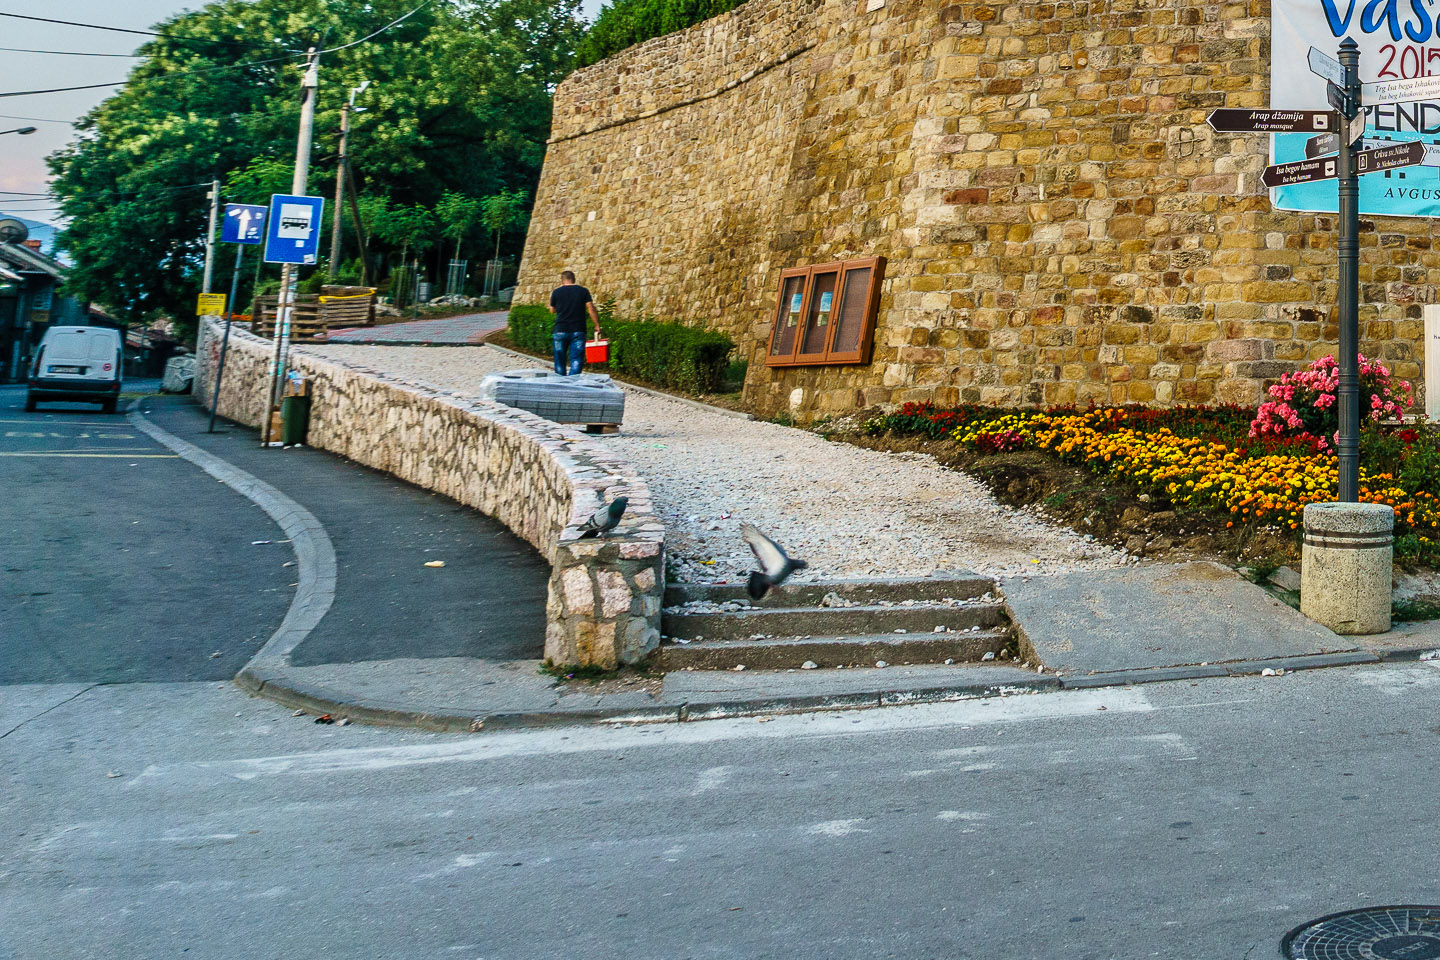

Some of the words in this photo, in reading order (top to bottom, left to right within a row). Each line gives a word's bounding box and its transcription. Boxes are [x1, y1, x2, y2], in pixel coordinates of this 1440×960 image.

[1375, 85, 1386, 93] Trg
[1249, 111, 1270, 121] Arap
[1272, 111, 1304, 121] džamija
[1276, 166, 1285, 174] Isa
[1285, 165, 1300, 174] begov
[1301, 162, 1320, 170] hamam
